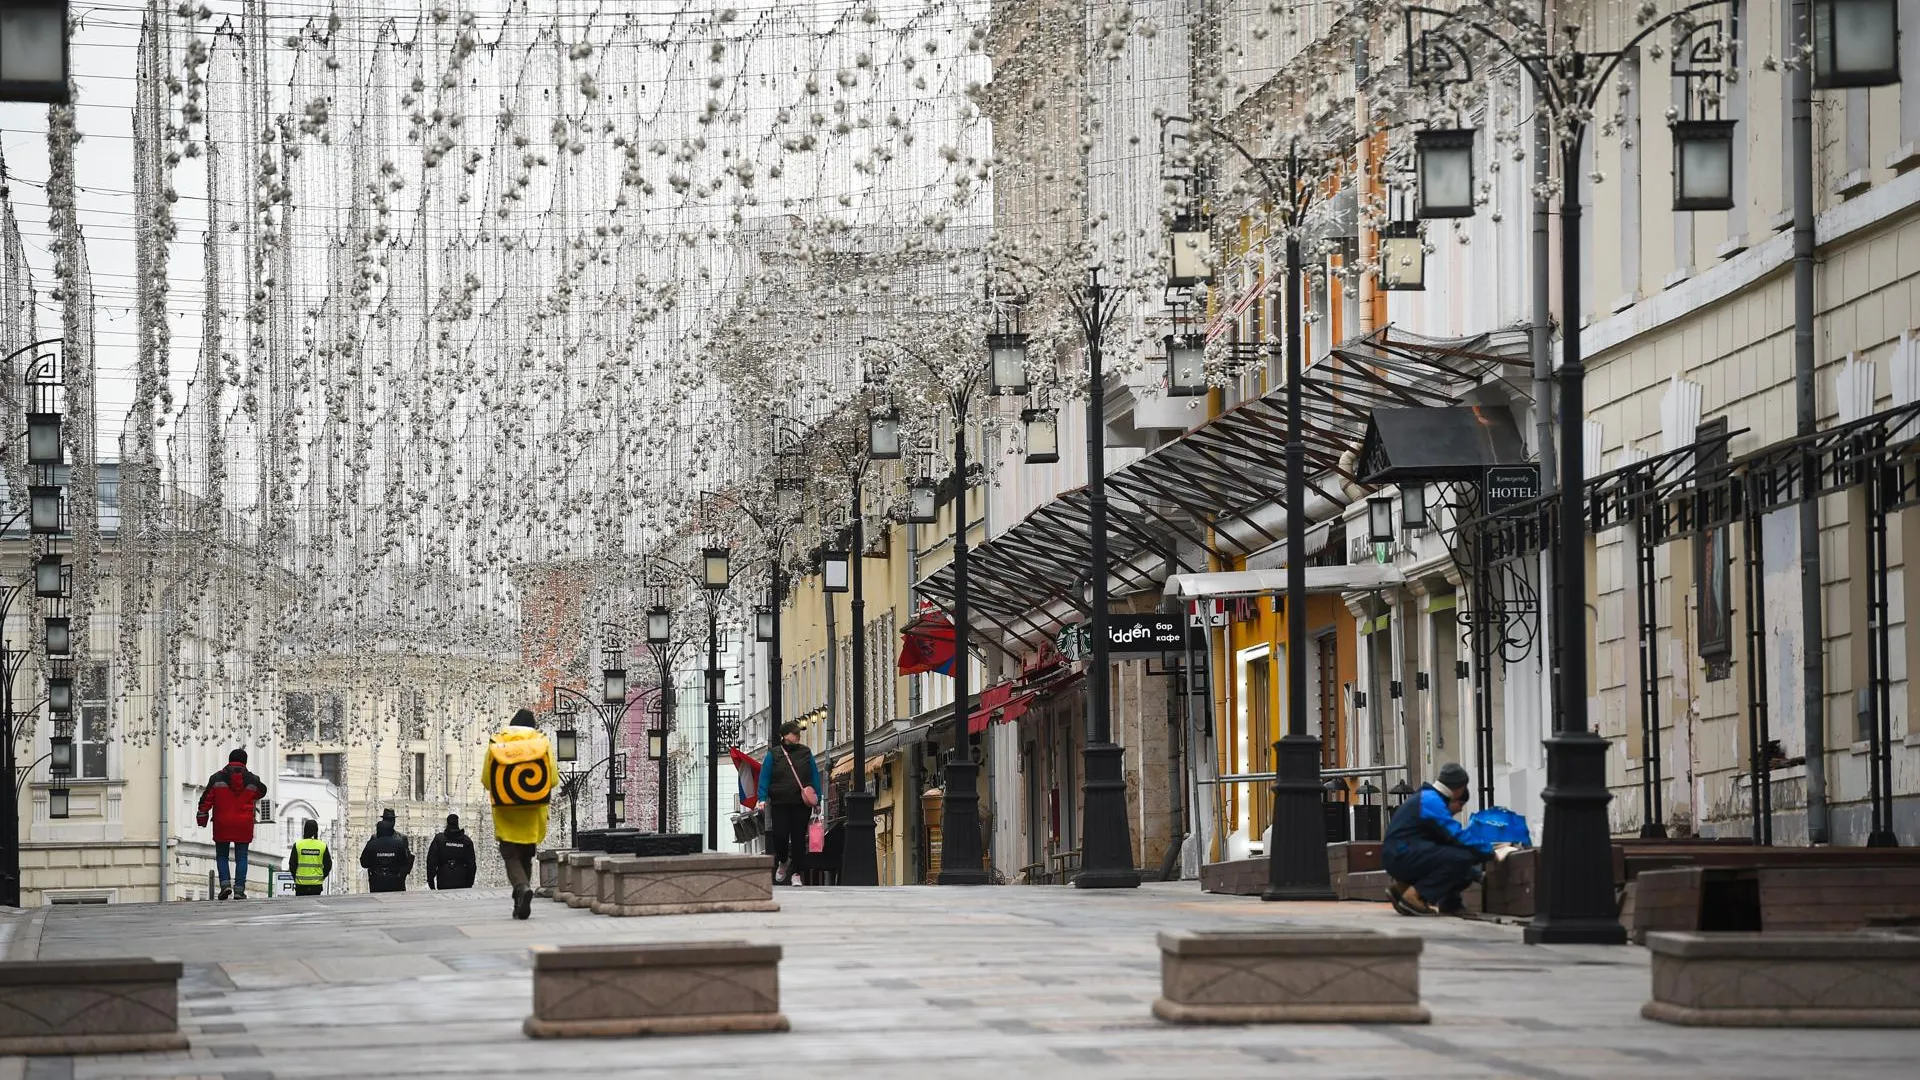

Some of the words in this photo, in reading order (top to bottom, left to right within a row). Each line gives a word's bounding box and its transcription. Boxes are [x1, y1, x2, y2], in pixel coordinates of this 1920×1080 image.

[1491, 487, 1535, 498] HOTEL
[1194, 615, 1219, 625] KC
[1155, 622, 1173, 632] бар
[1108, 623, 1151, 643] idden
[1156, 633, 1181, 643] кафе
